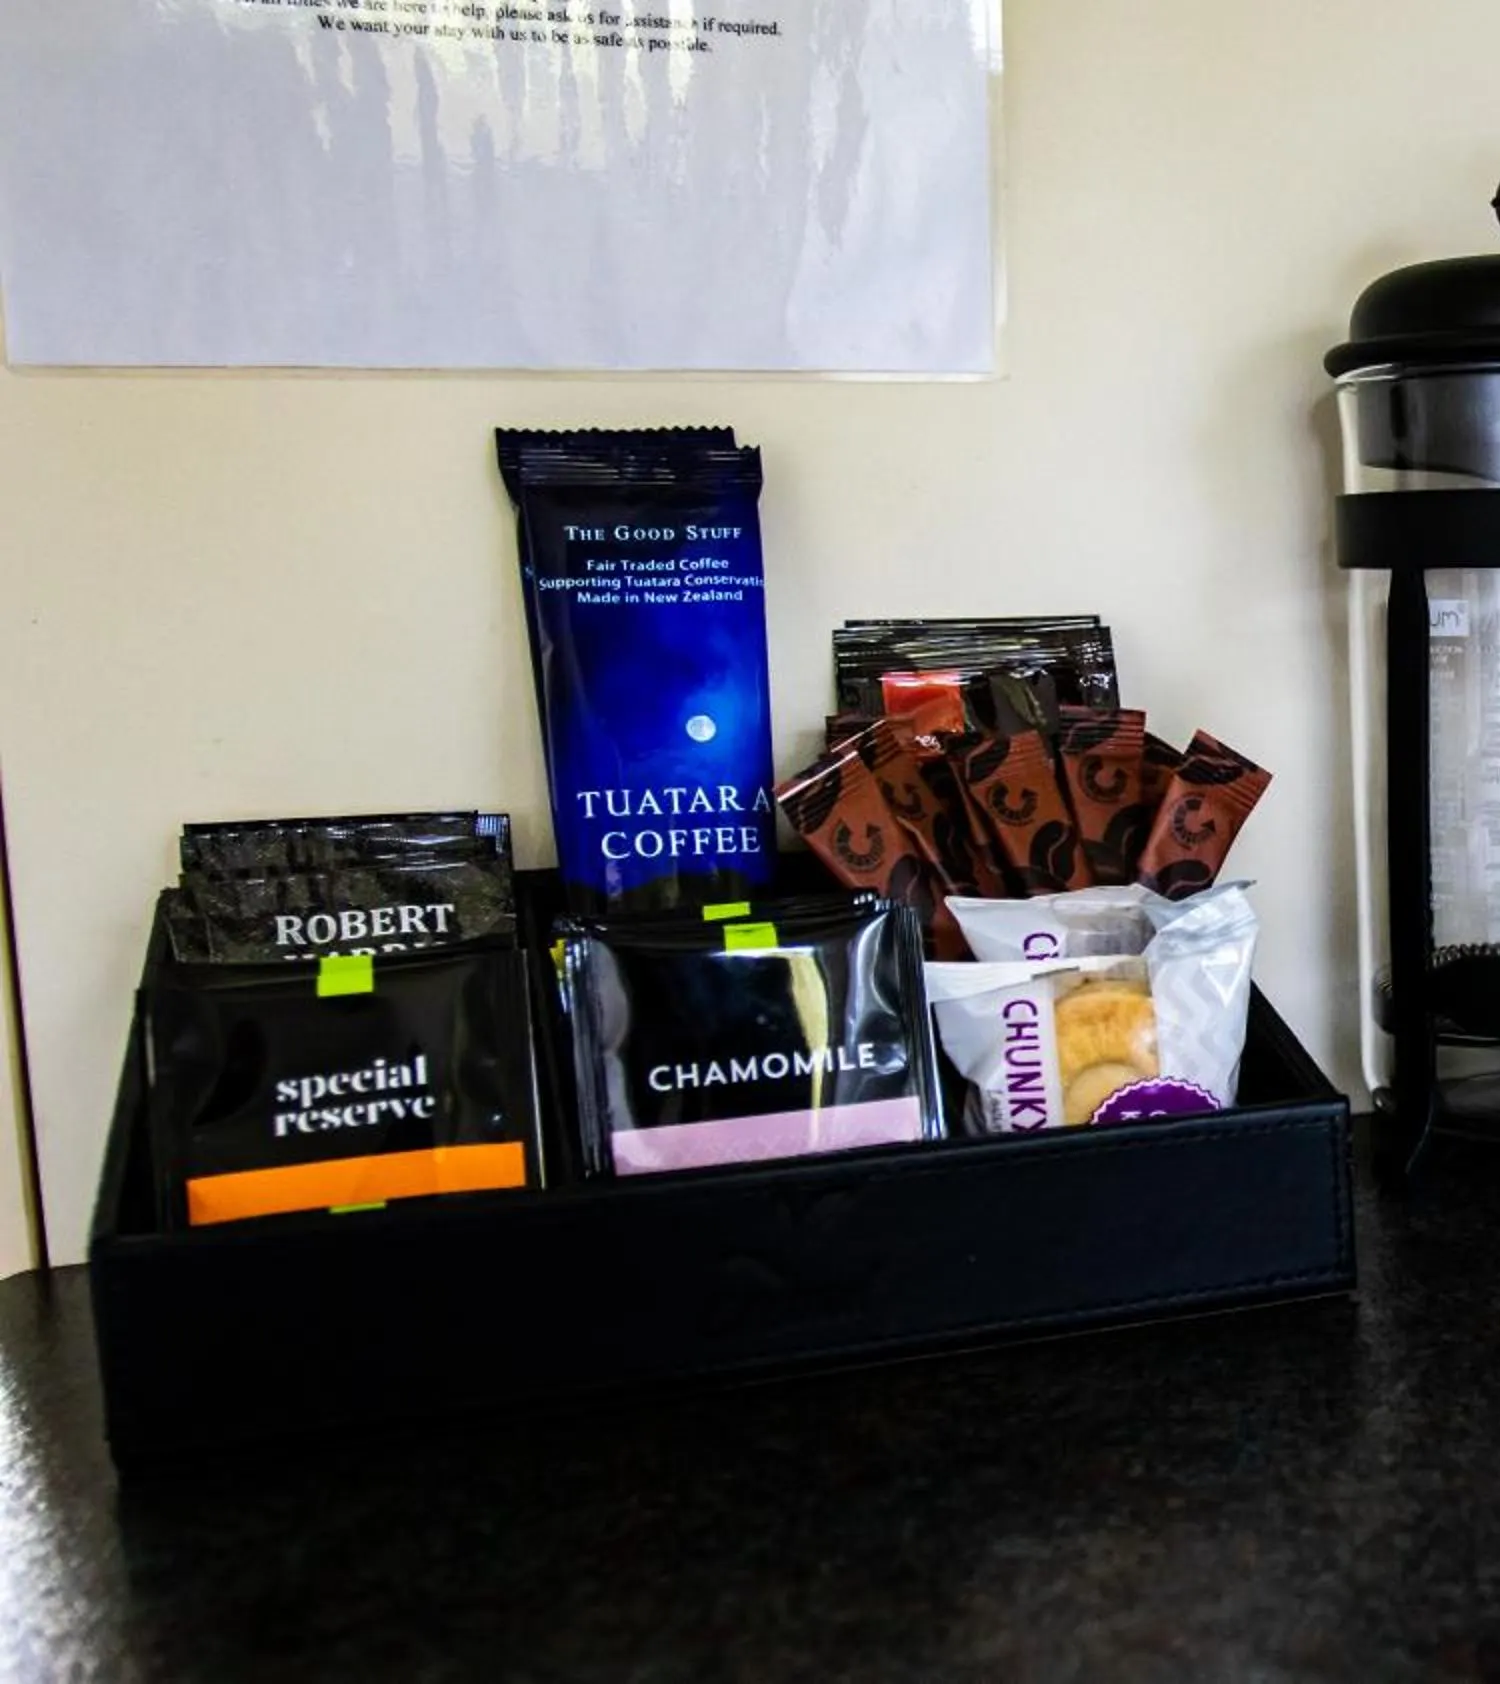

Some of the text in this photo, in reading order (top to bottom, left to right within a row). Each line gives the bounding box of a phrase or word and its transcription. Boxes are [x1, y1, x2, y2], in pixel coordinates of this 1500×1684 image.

[318, 15, 346, 31] We
[350, 20, 390, 33] want
[393, 22, 430, 38] your
[510, 30, 528, 41] us
[531, 31, 547, 42] to
[551, 30, 569, 43] be
[593, 32, 623, 47] safe
[547, 9, 573, 22] ask
[599, 10, 621, 25] for
[703, 18, 716, 31] if
[718, 20, 782, 37] required.
[564, 525, 742, 541] THE GOOD STUFF
[586, 557, 729, 571] Fair Traded Coffee
[538, 576, 621, 592] Supporting
[624, 574, 681, 587] Tuatara
[577, 588, 743, 604] Made in New Zealand
[577, 785, 772, 818] TUATARA
[601, 827, 761, 859] COFFEE
[275, 904, 455, 946] ROBERT
[276, 1055, 429, 1109] special
[648, 1042, 878, 1092] CHAMOMILE
[1002, 999, 1048, 1133] CHUNKY
[273, 1095, 437, 1138] reserve
